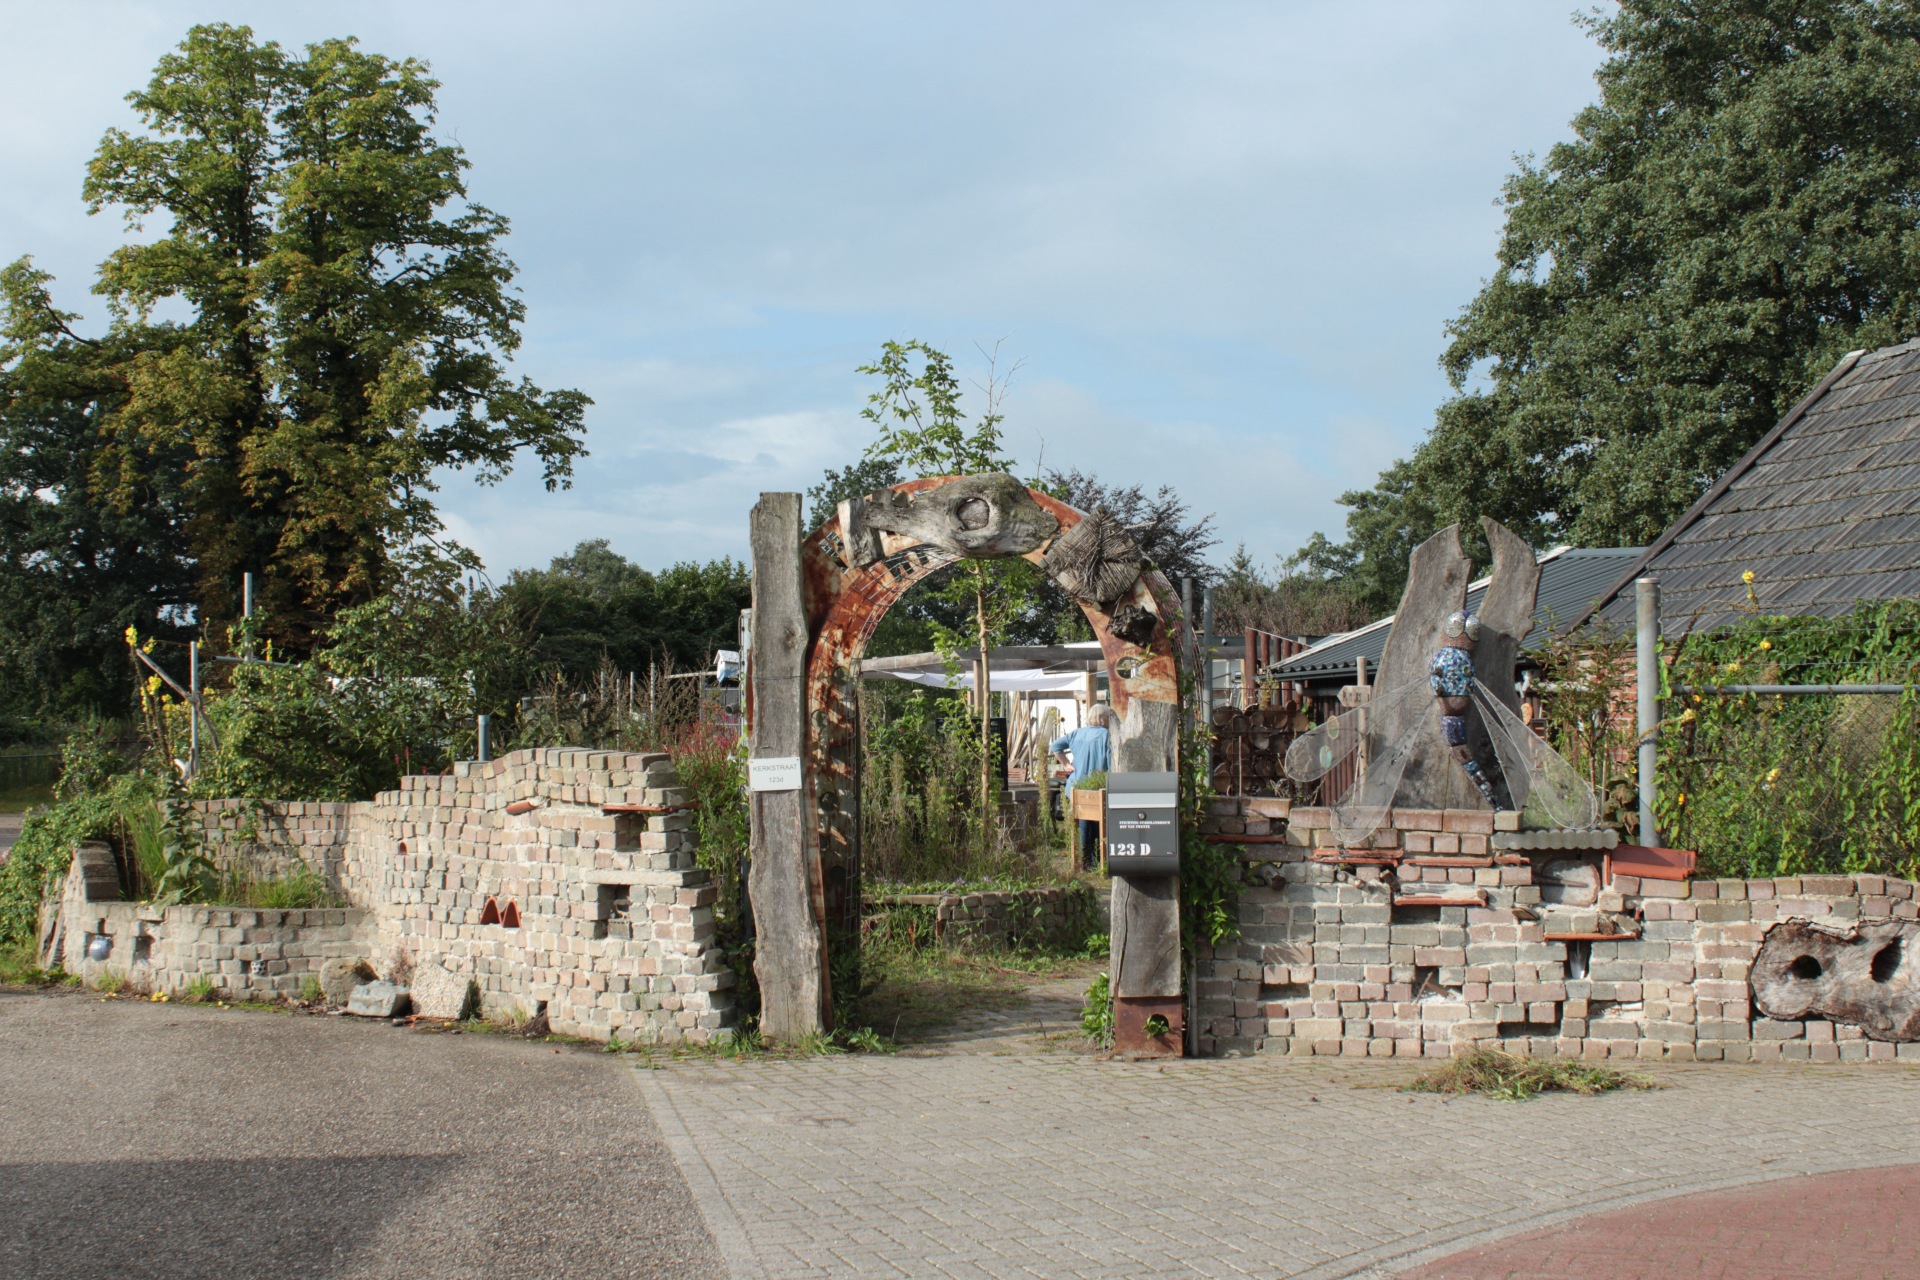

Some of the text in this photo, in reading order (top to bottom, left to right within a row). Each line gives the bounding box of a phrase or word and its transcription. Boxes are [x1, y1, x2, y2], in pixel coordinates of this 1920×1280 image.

[753, 764, 797, 772] KERKSTRAAT
[1109, 843, 1151, 856] 123 D
